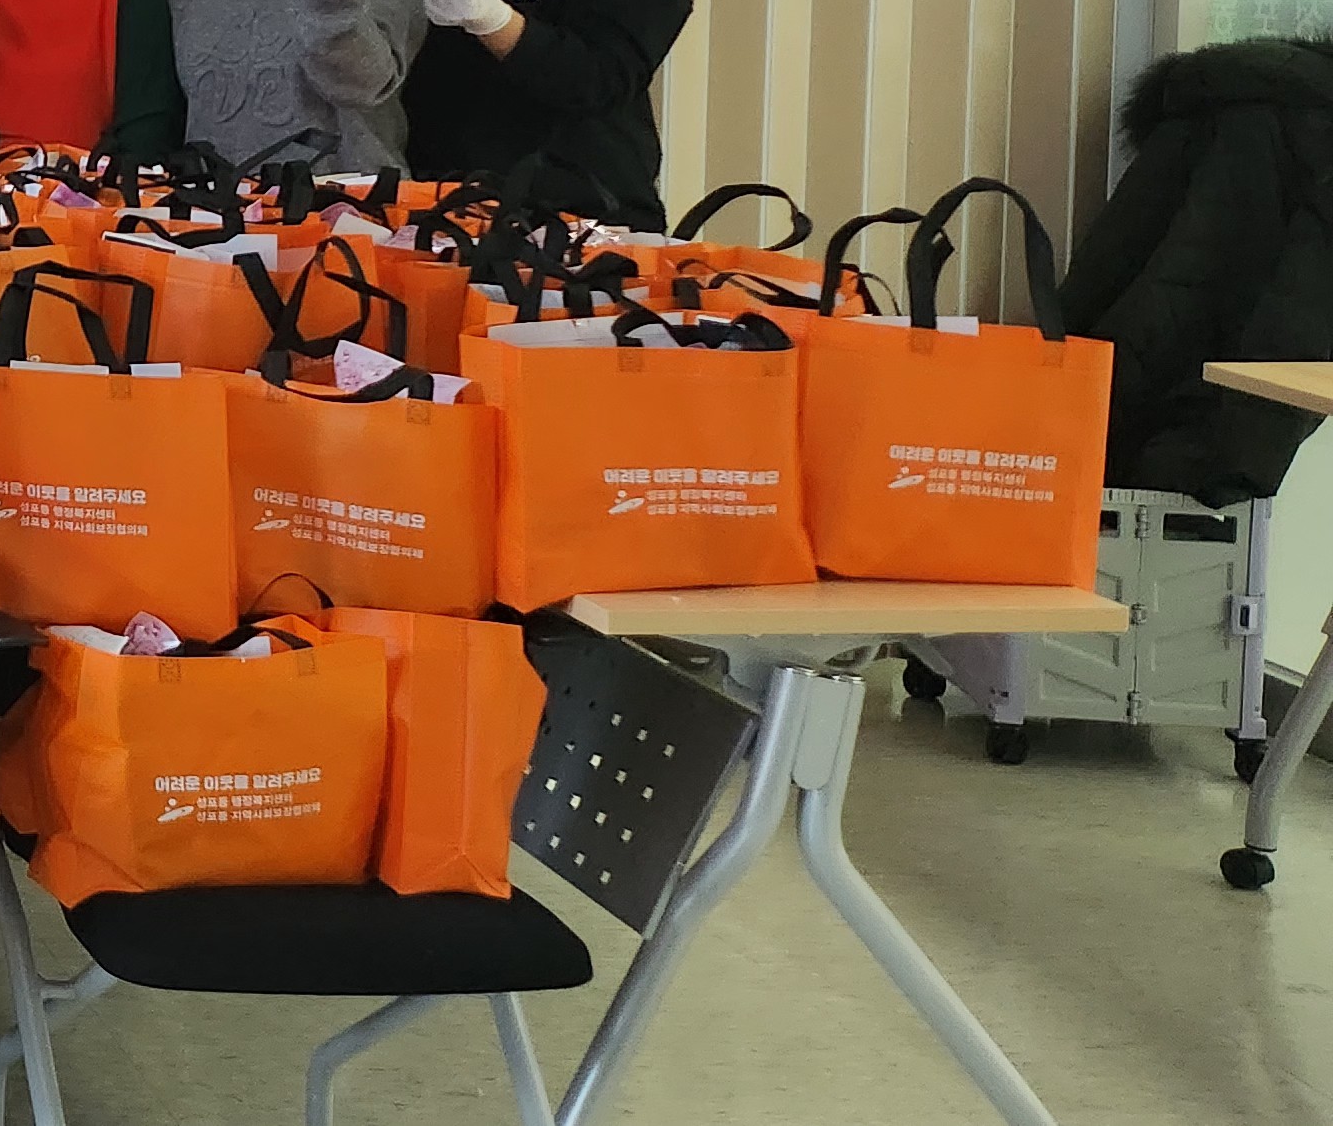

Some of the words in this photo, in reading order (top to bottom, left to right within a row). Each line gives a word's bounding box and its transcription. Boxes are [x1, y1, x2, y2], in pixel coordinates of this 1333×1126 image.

[27, 484, 71, 502] 이웃을
[74, 487, 146, 505] 알려주세요
[155, 776, 200, 792] 어려운
[204, 774, 249, 791] 이웃을
[253, 767, 321, 788] 알려주세요
